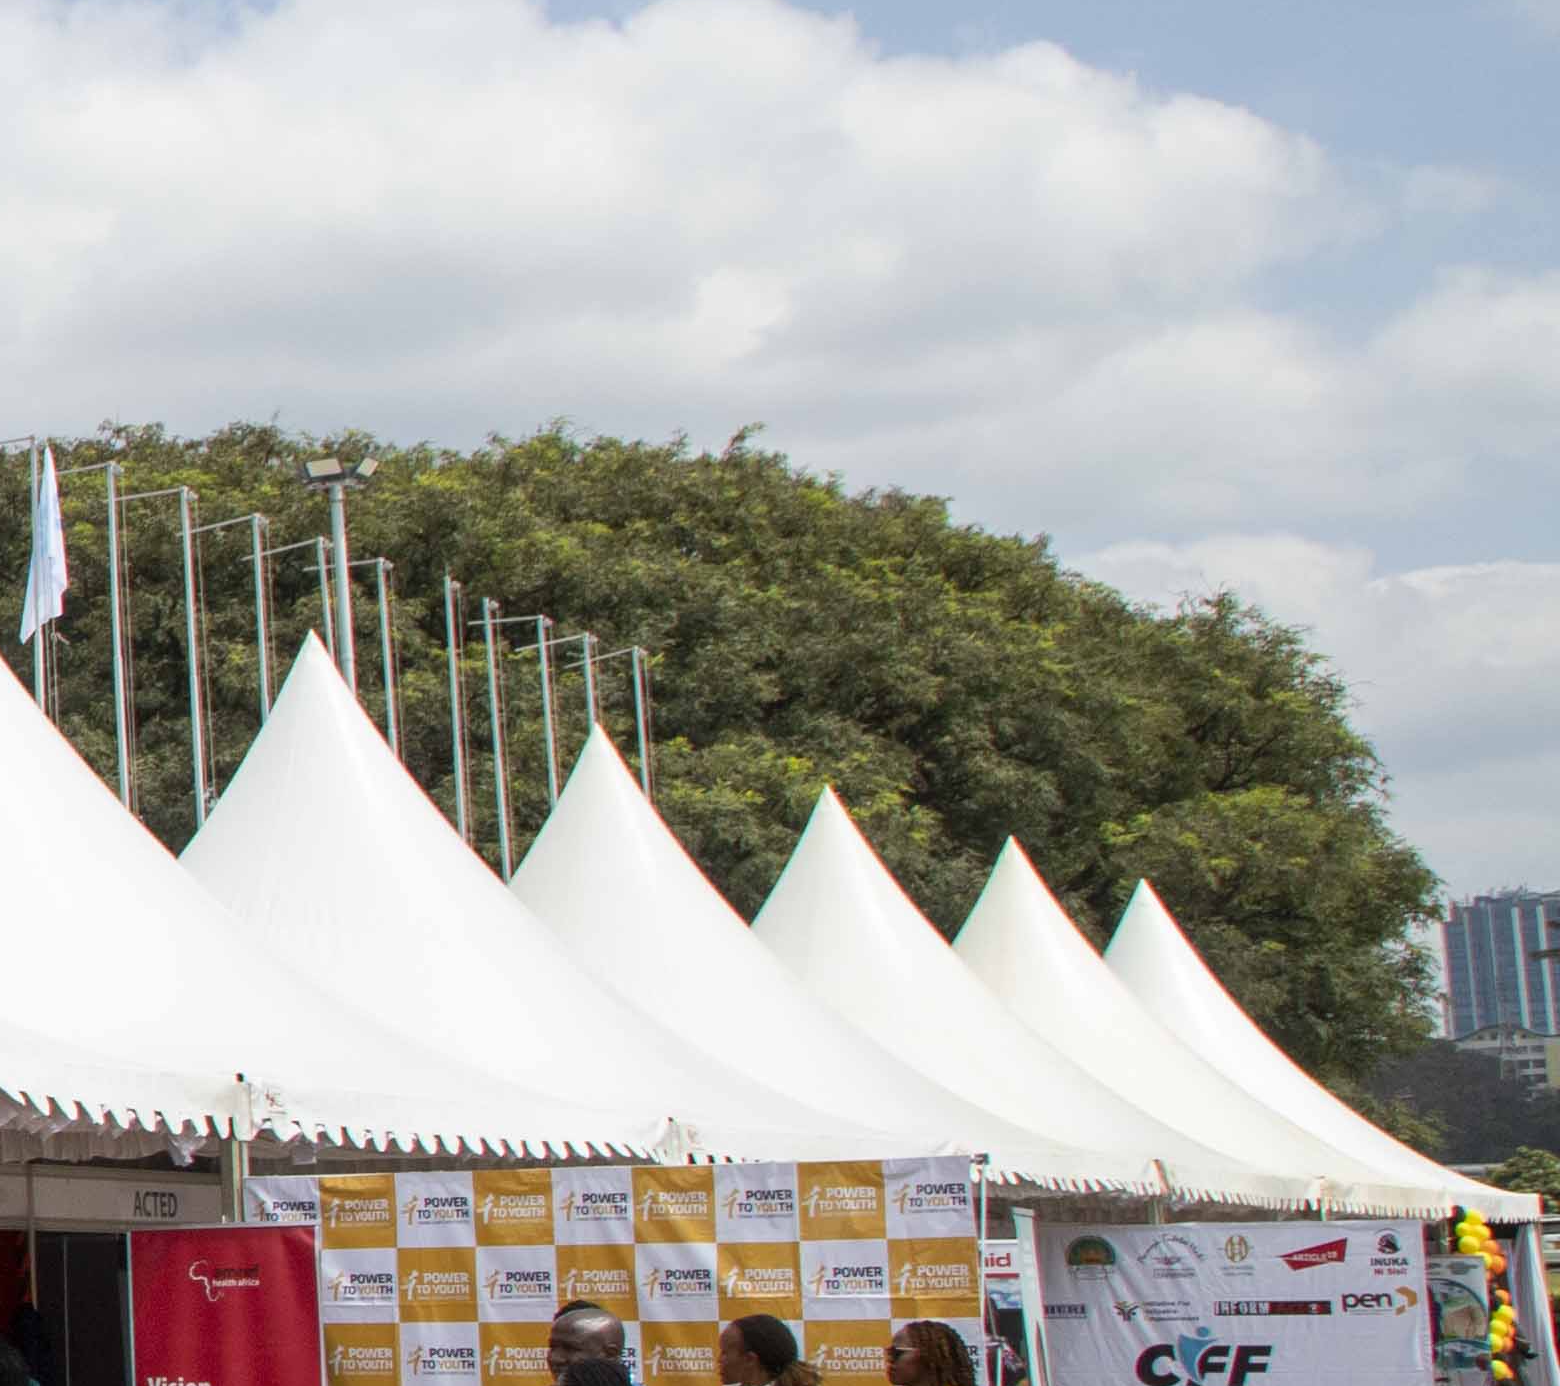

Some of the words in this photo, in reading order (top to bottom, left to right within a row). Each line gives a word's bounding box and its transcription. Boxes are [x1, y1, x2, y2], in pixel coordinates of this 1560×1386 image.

[916, 1183, 966, 1197] POWER
[134, 1191, 178, 1218] ACTED
[424, 1196, 469, 1208] POWER
[908, 1195, 922, 1207] TO
[925, 1194, 967, 1207] YOUTH
[416, 1209, 430, 1220] TO
[431, 1209, 469, 1221] YOUTH
[1342, 1292, 1392, 1312] pen
